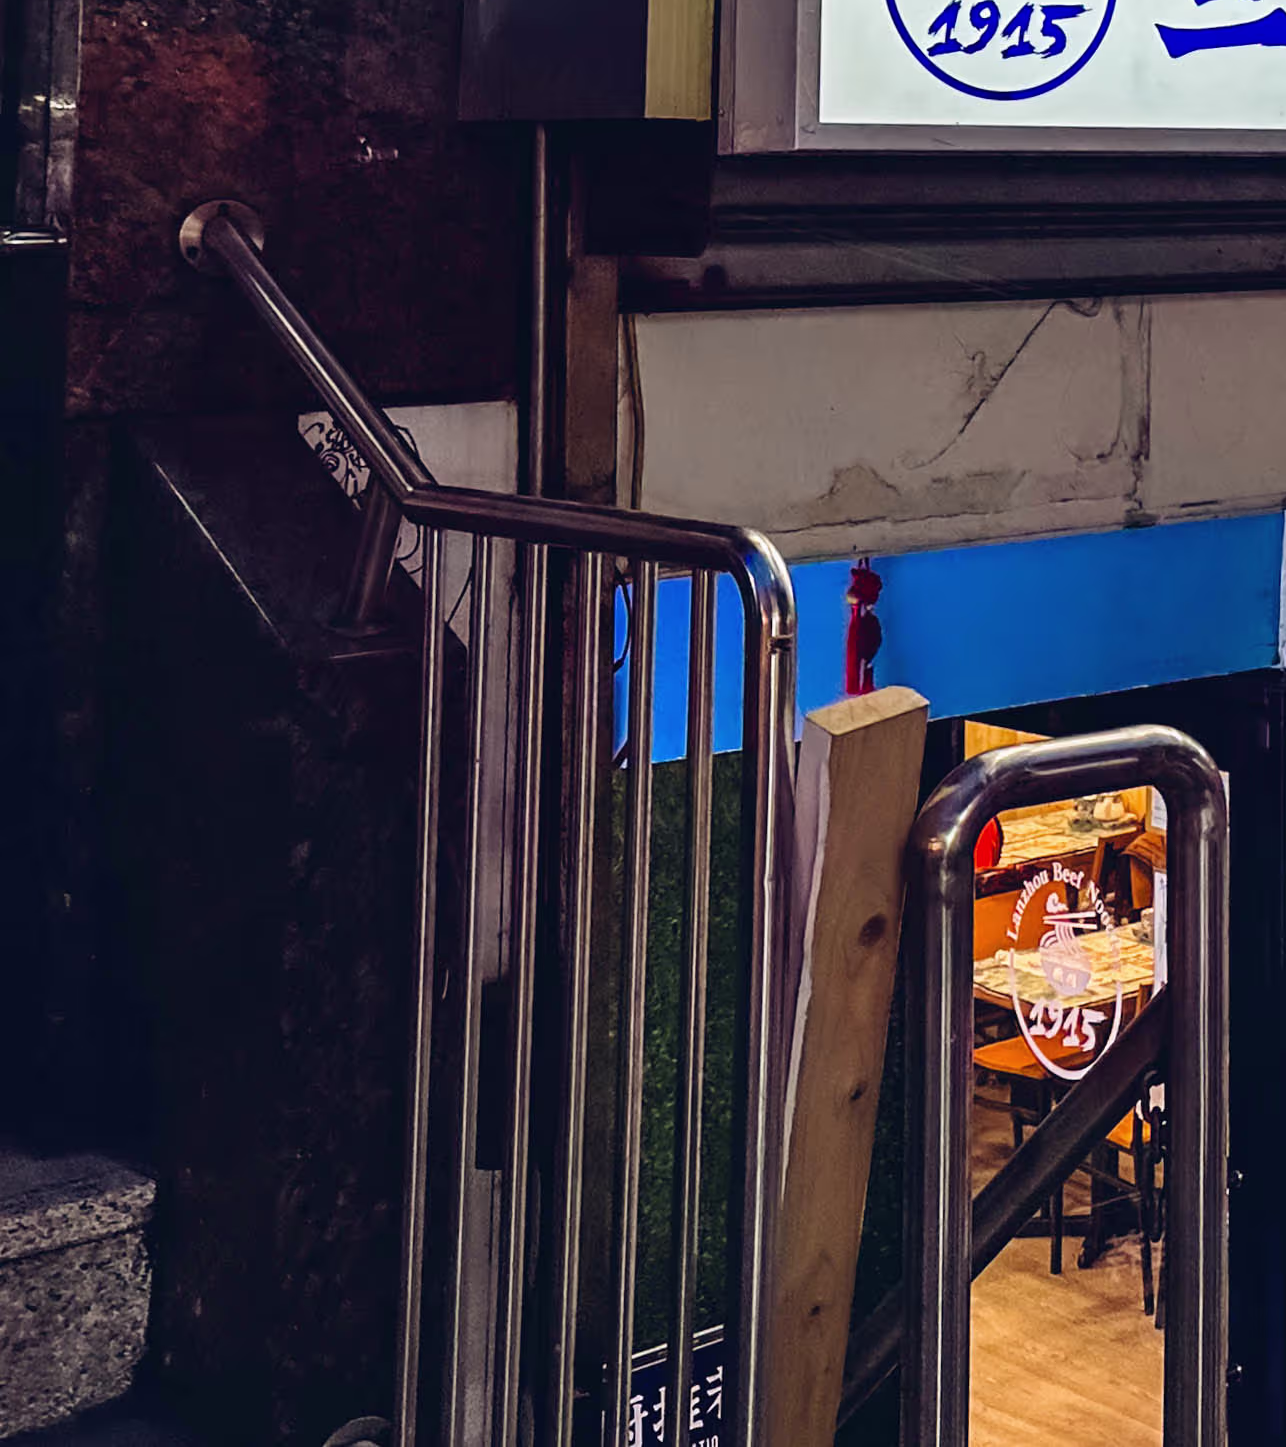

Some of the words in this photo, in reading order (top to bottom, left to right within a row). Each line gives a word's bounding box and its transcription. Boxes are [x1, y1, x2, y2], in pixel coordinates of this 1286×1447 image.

[1006, 870, 1049, 942] Lanzhou
[1052, 862, 1085, 890] Beef
[1028, 997, 1108, 1052] 1915
